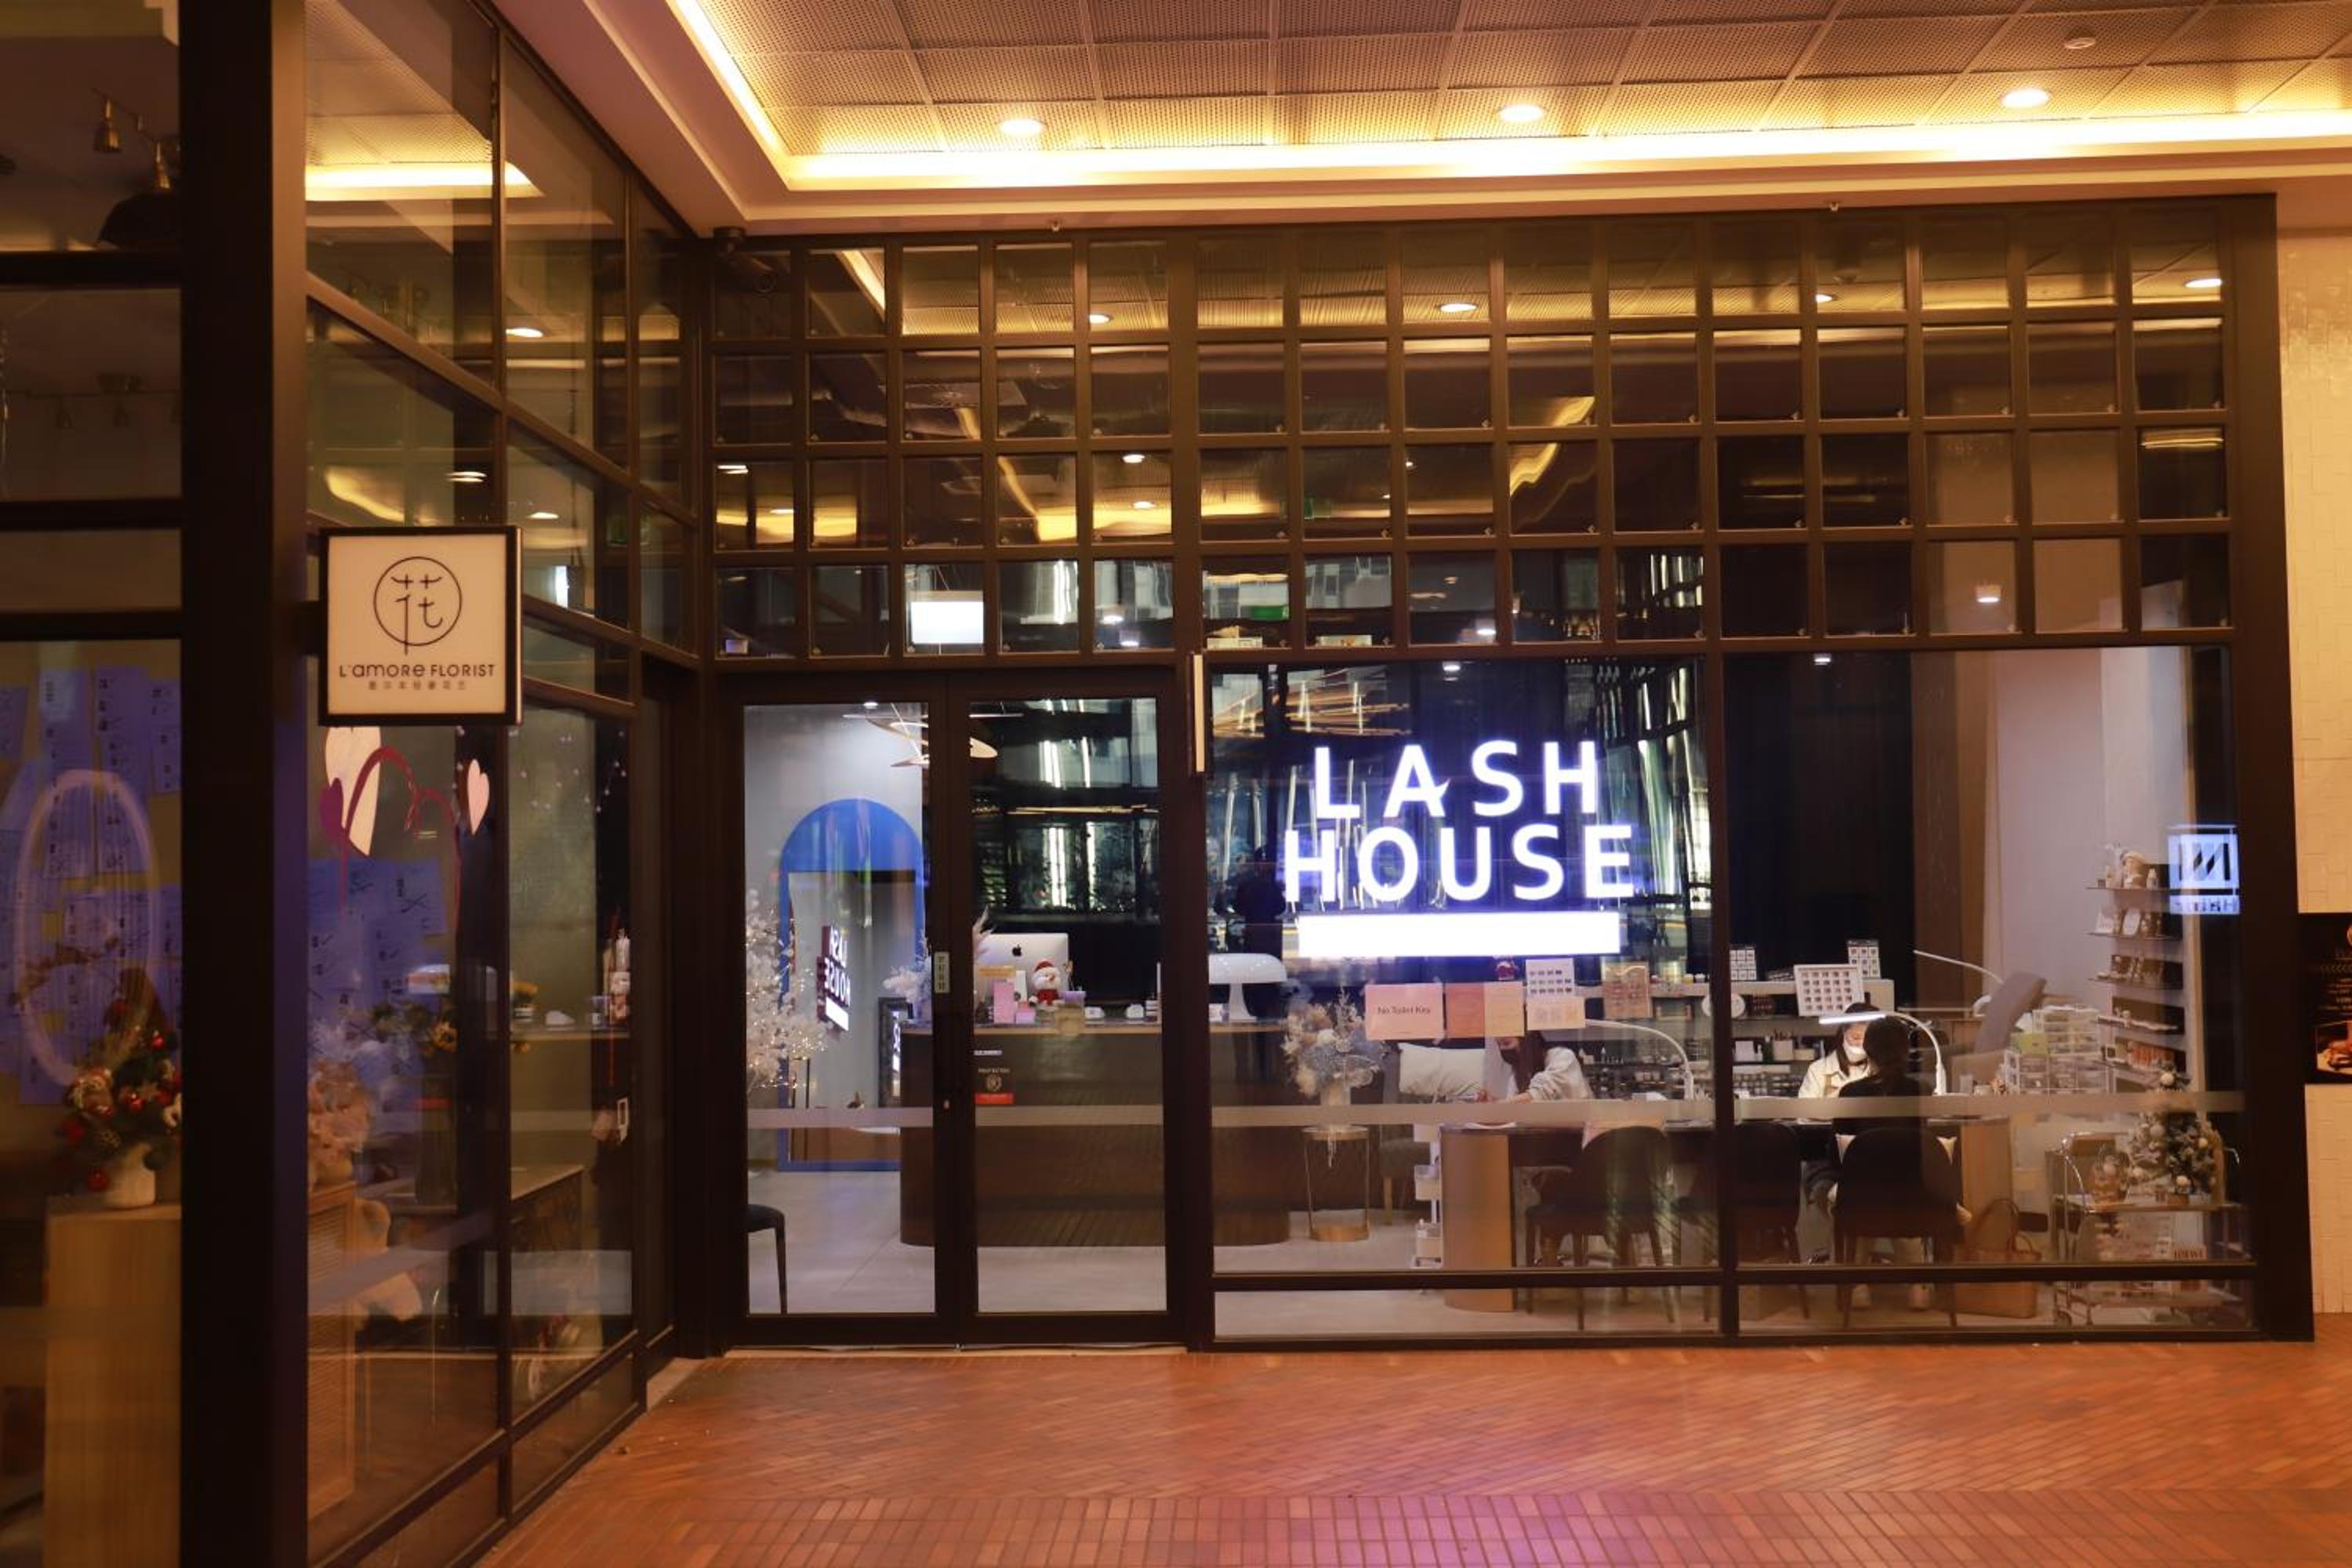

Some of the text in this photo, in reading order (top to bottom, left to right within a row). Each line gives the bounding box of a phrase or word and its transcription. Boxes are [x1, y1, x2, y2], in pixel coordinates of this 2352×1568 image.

[390, 572, 445, 655] 花
[430, 663, 495, 677] FLORIST
[1312, 739, 1599, 819] LASH
[1283, 823, 1635, 904] HOUSE
[1377, 1005, 1390, 1015] No
